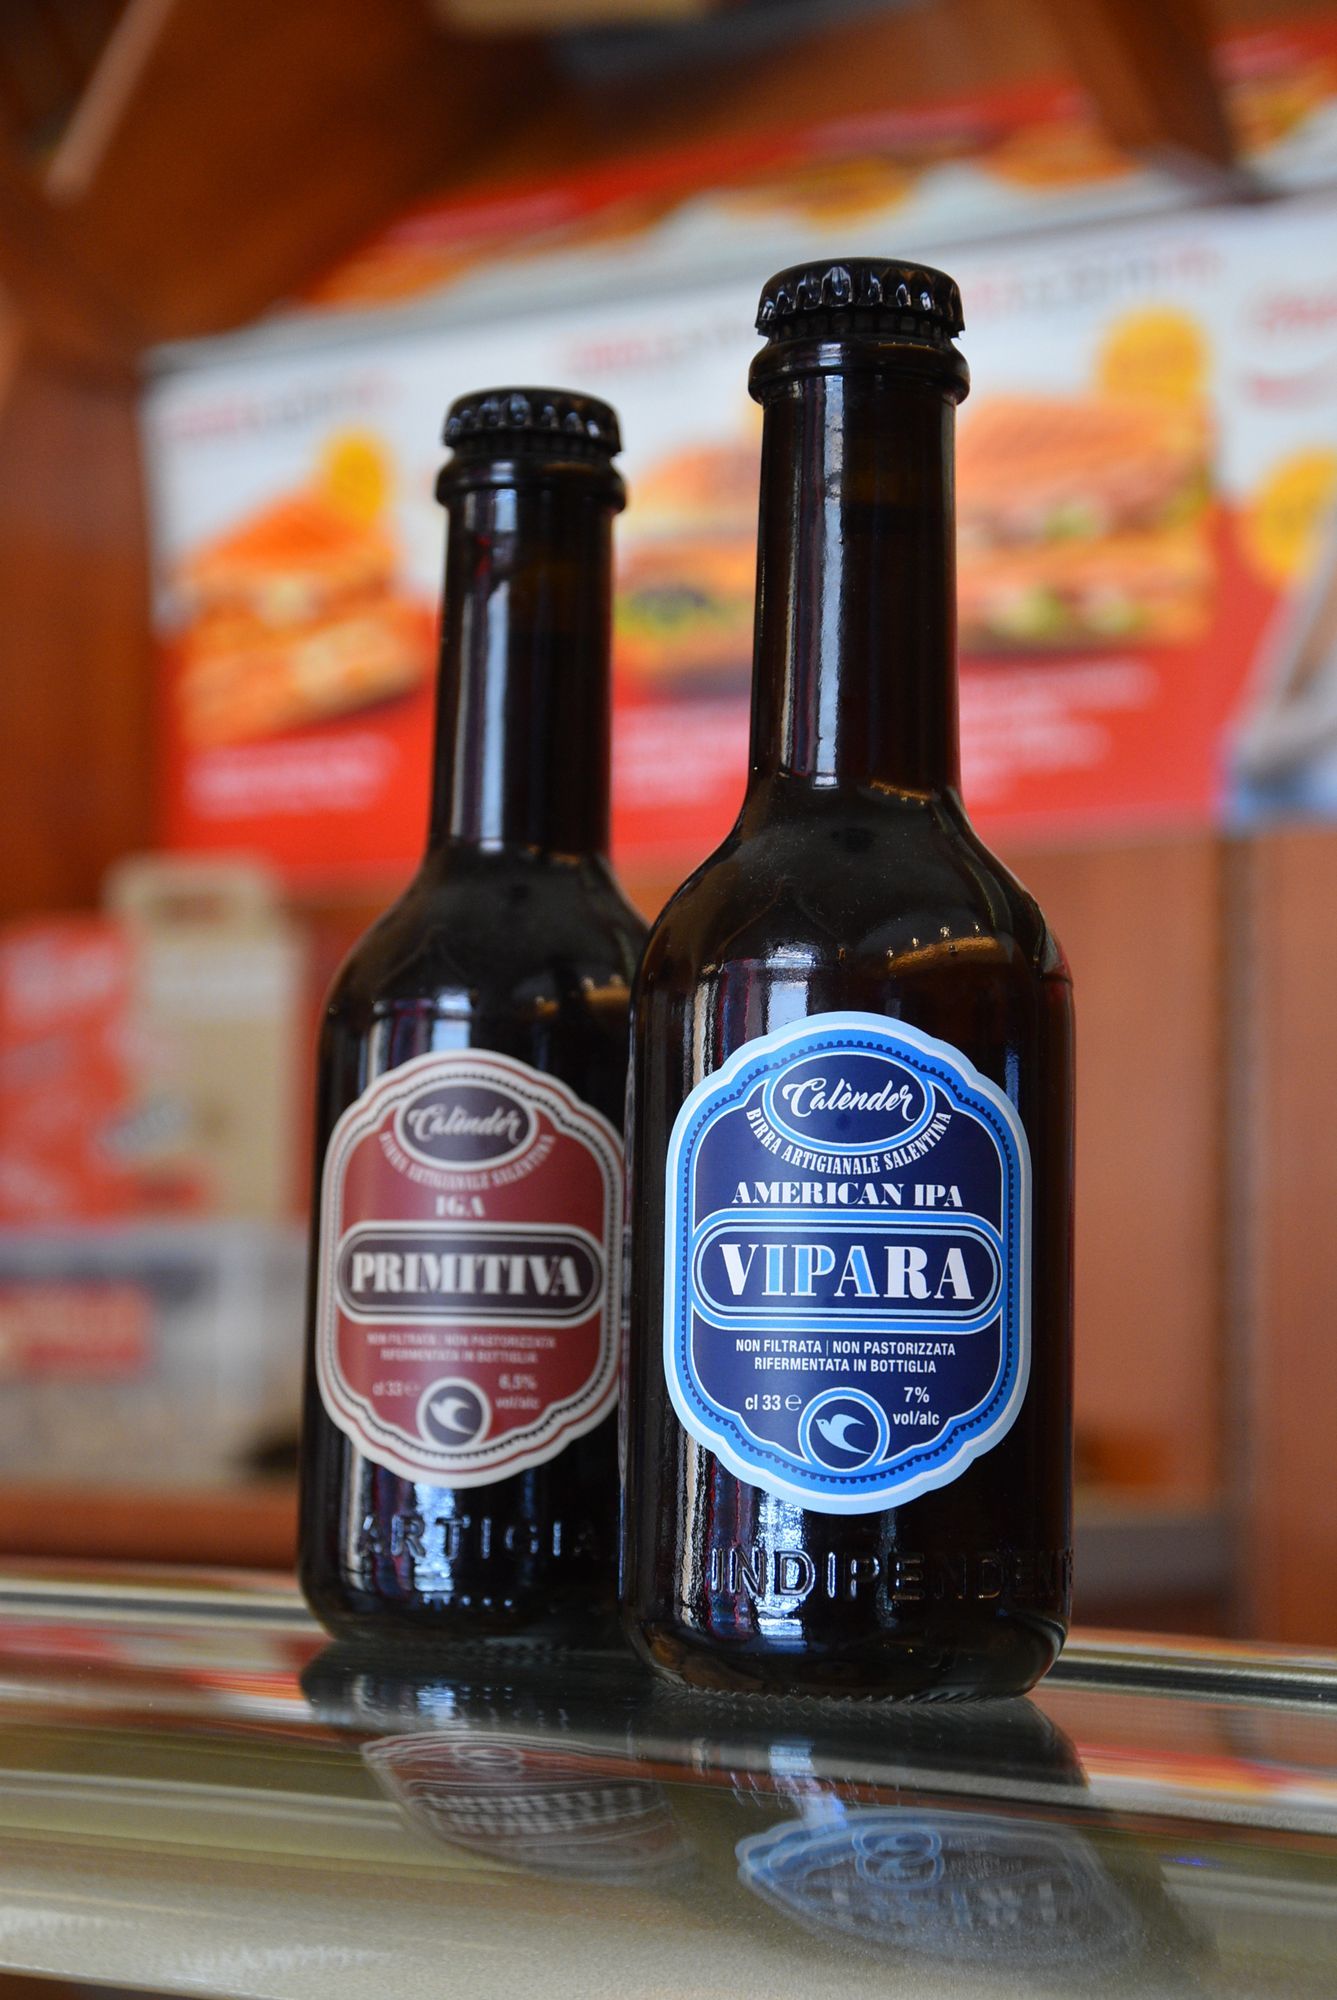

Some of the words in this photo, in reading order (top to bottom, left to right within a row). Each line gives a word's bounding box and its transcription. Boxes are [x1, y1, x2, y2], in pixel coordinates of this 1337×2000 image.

[782, 1076, 916, 1122] Calènder
[745, 1107, 782, 1154] BIRRA
[781, 1144, 882, 1175] ARTIGIANALE
[883, 1111, 953, 1172] SALENTINA
[434, 1194, 486, 1218] IGA
[731, 1180, 906, 1207] AMERICAN
[913, 1183, 964, 1208] IPA
[351, 1251, 582, 1297] PRIMITIVA
[719, 1243, 975, 1300] VIPARA
[735, 1339, 761, 1354] NON
[764, 1339, 823, 1354] FILTRATA
[832, 1340, 861, 1355] NON
[863, 1341, 956, 1357] PASTORIZZATA
[754, 1356, 851, 1372] RIFERMENTATA
[853, 1357, 867, 1373] IN
[870, 1358, 937, 1374] BOTTIGLIA
[744, 1394, 759, 1411] cl
[761, 1394, 782, 1411] 33
[903, 1386, 930, 1405] 7%
[892, 1410, 941, 1427] vol/alc
